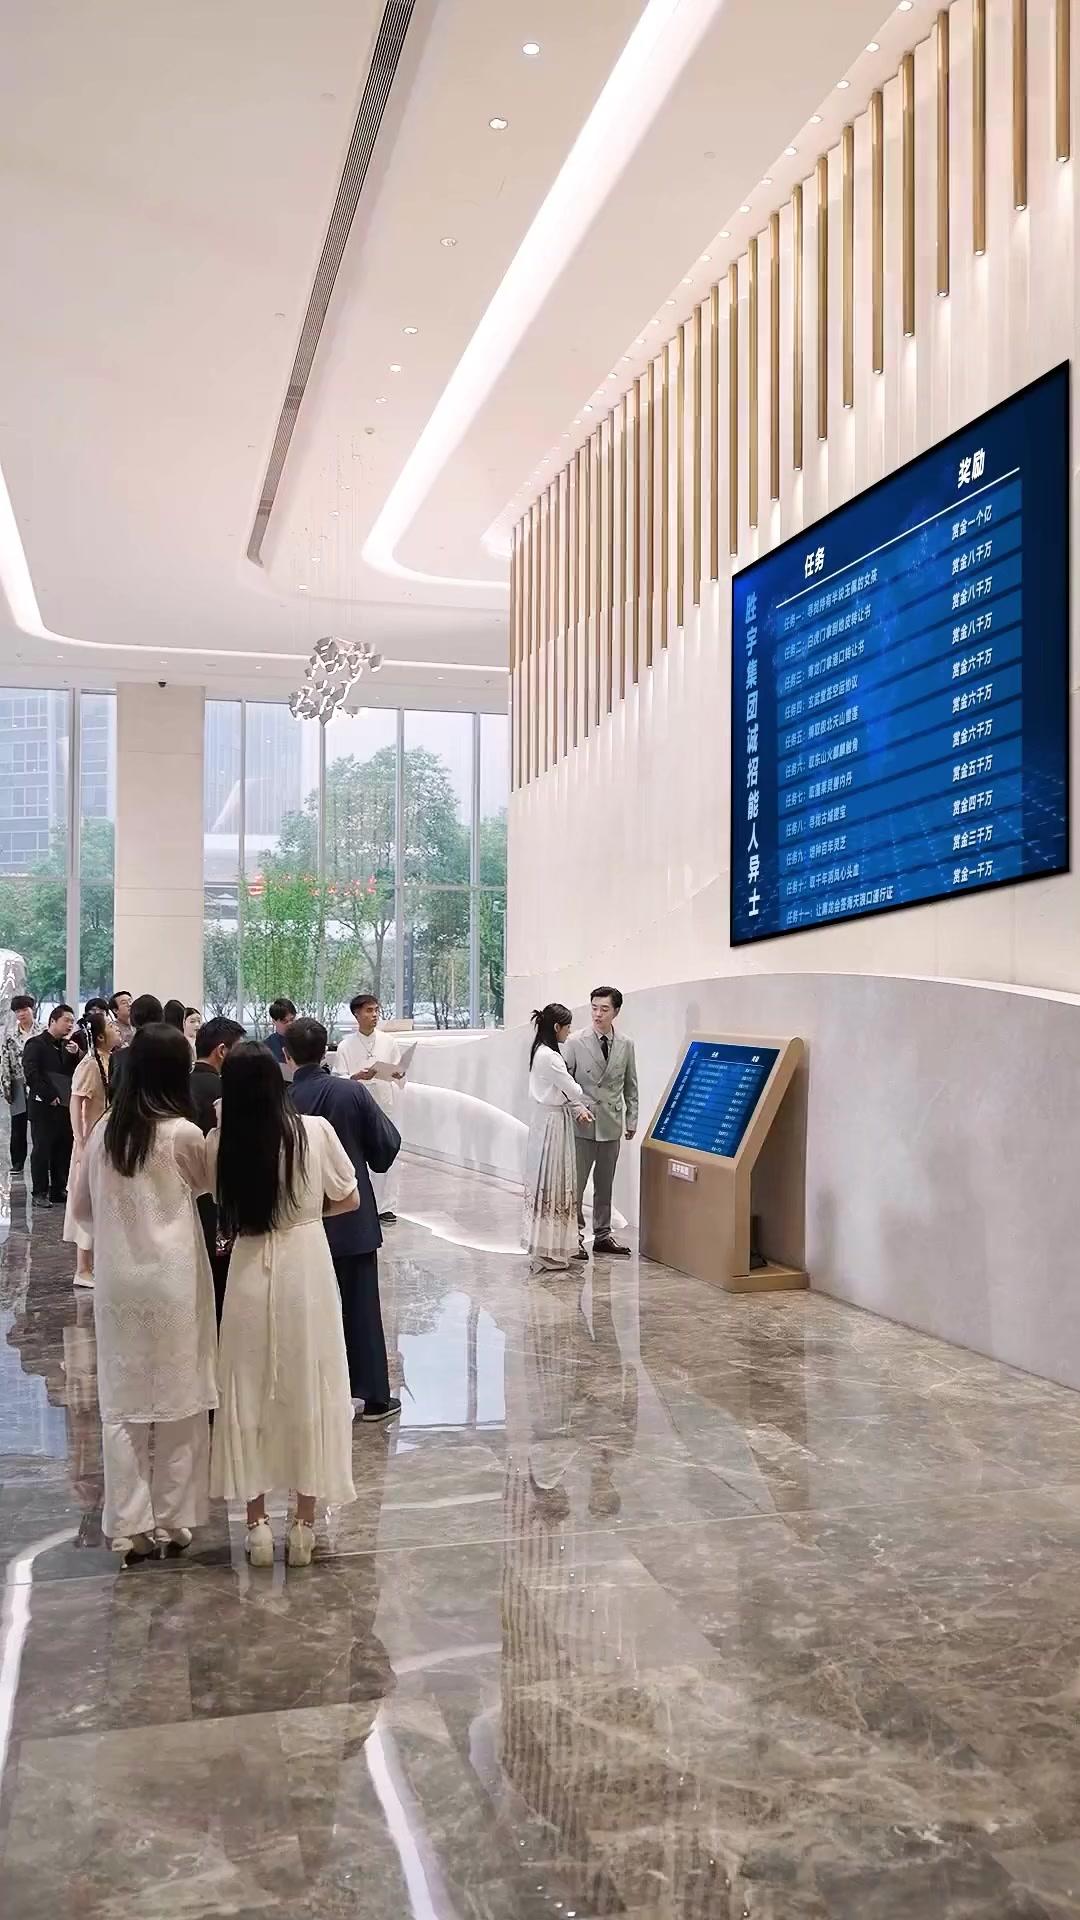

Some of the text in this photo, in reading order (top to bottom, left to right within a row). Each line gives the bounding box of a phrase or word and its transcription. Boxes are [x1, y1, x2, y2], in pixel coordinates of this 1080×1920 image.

[958, 448, 985, 488] 奖励
[951, 504, 993, 540] 赏金一个亿
[804, 546, 825, 579] 任务
[951, 541, 992, 575] 赏金八千万
[951, 577, 992, 610] 赏金八千万
[951, 612, 992, 645] 赏金八千万
[951, 648, 992, 679] 赏金六千万
[951, 683, 992, 714] 赏金六千万
[951, 719, 992, 749] 赏金六千万
[745, 591, 761, 917] 胜宇集团诚招能人异士
[951, 755, 992, 783] 赏金五千万
[951, 790, 992, 818] 赏金四千万
[951, 825, 992, 852] 赏金三千万
[951, 861, 992, 886] 赏金一千万
